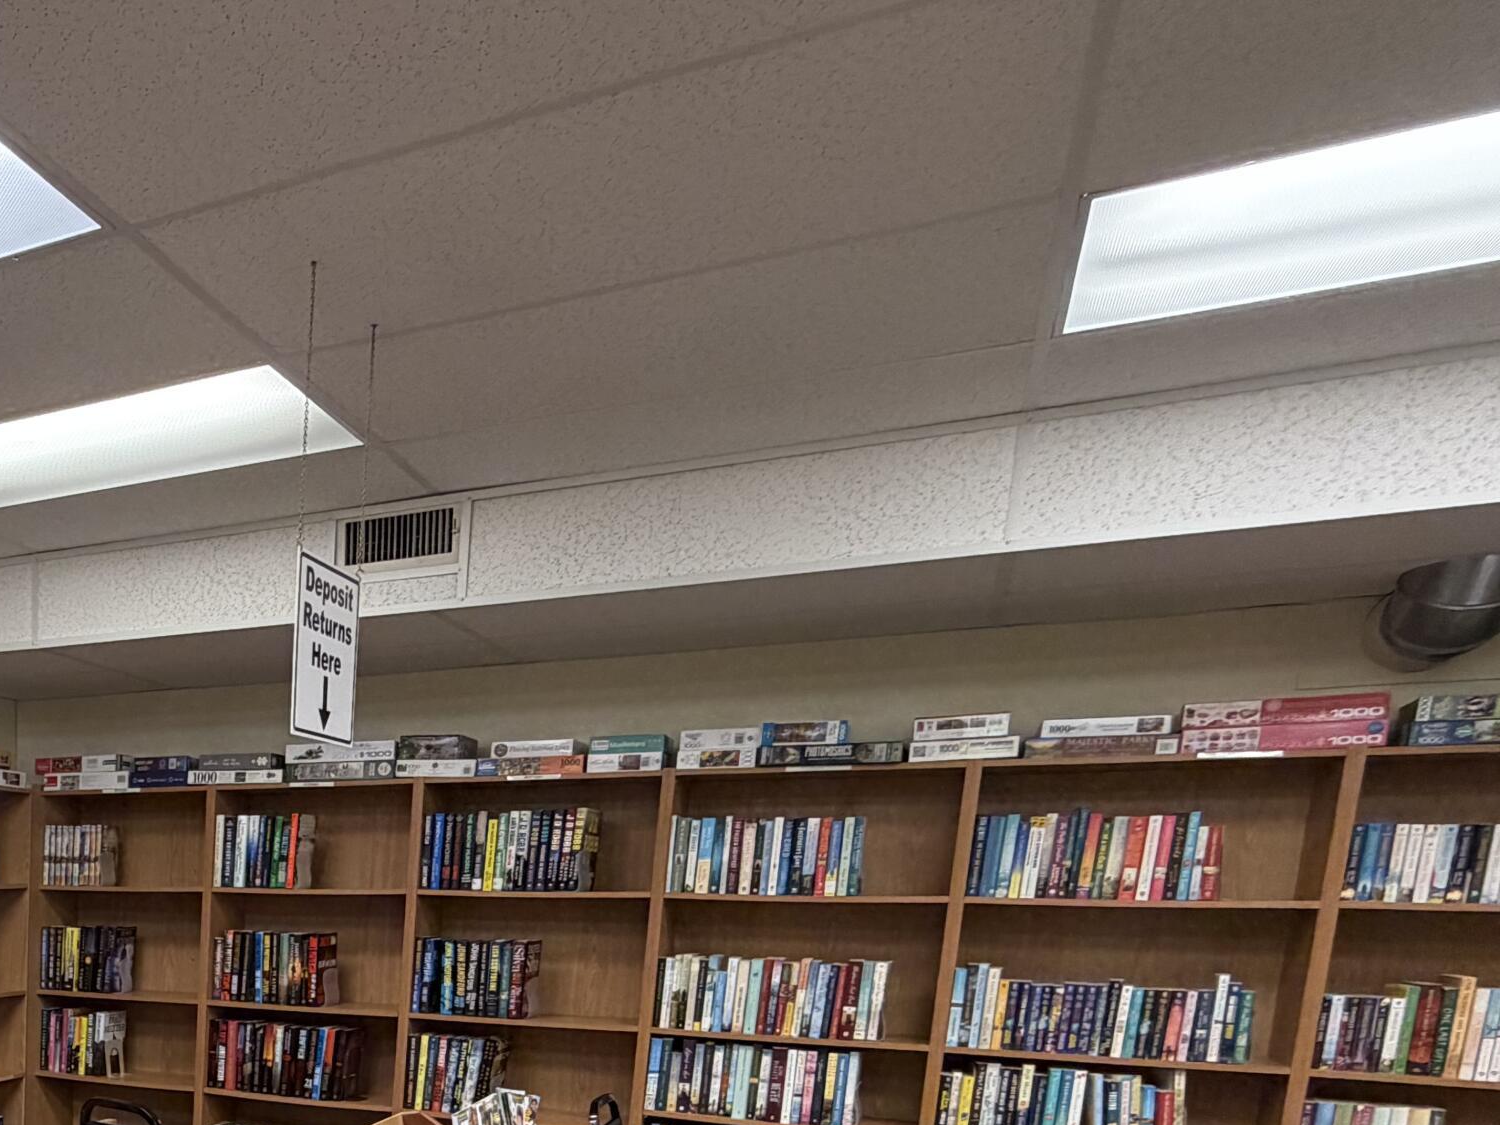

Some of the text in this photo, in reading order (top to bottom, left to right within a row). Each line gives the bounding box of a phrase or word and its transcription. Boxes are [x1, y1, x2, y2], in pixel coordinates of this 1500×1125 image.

[306, 565, 354, 612] Deposit
[303, 601, 352, 646] Returns
[311, 641, 341, 676] Here
[1328, 733, 1383, 746] 1000
